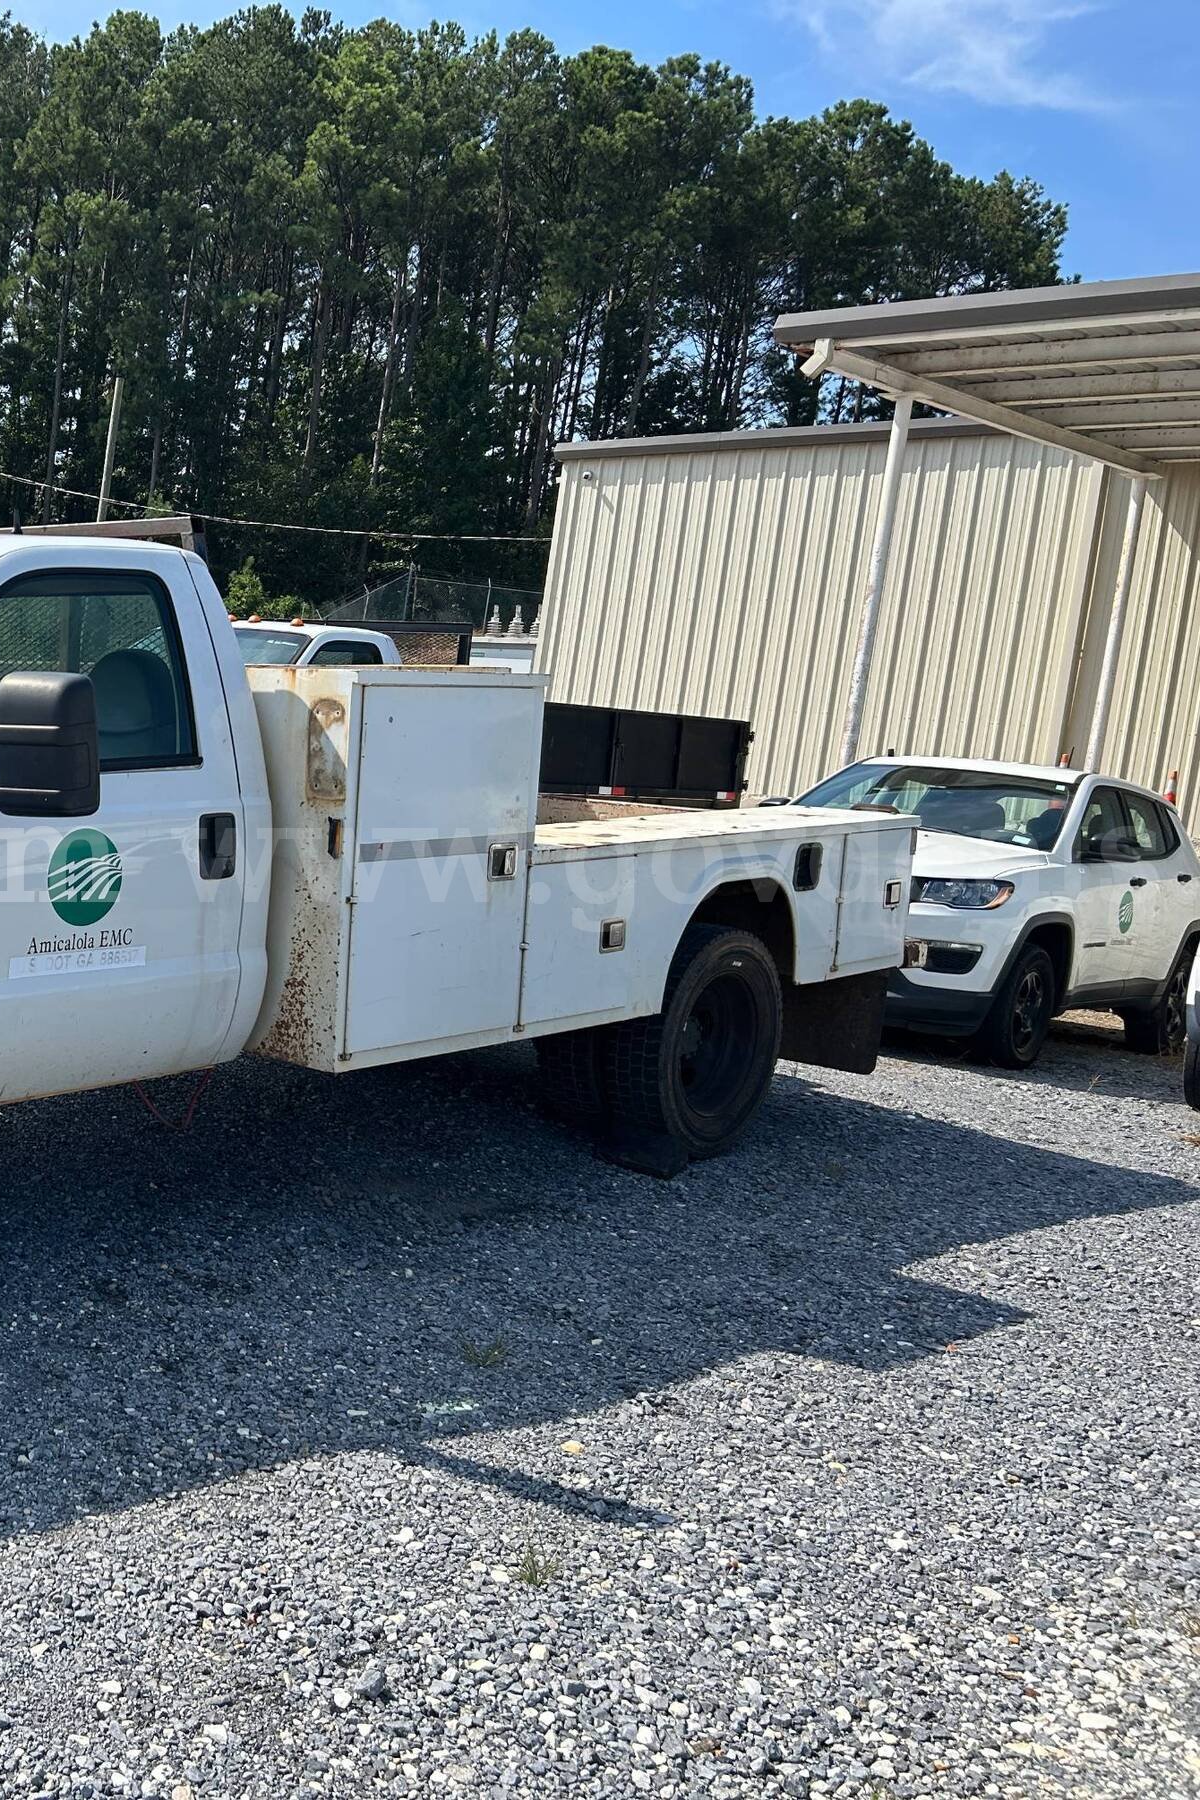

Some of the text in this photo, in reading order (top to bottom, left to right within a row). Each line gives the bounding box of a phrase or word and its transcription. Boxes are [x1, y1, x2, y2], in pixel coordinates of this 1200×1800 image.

[27, 928, 133, 955] Amicalola EMC
[76, 952, 94, 968] GA
